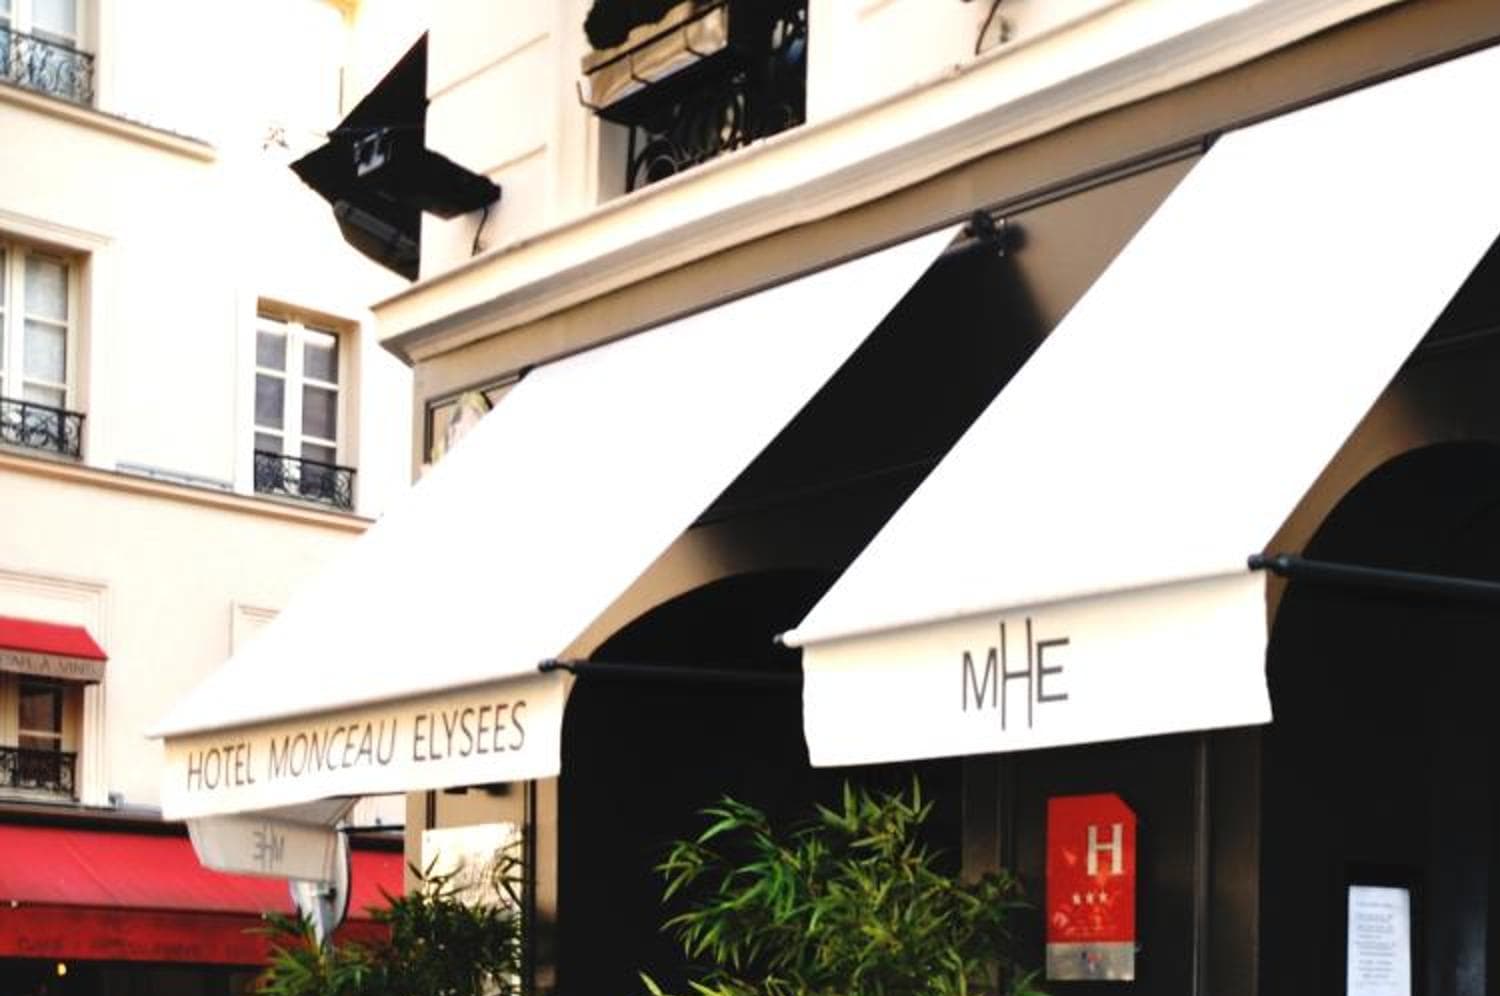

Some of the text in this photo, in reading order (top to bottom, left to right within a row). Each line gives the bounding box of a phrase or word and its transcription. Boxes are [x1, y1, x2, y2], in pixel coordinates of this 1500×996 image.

[961, 617, 1070, 731] MHE
[187, 700, 527, 792] HOTEL MONCEAU ELYSEES
[1086, 822, 1125, 876] H
